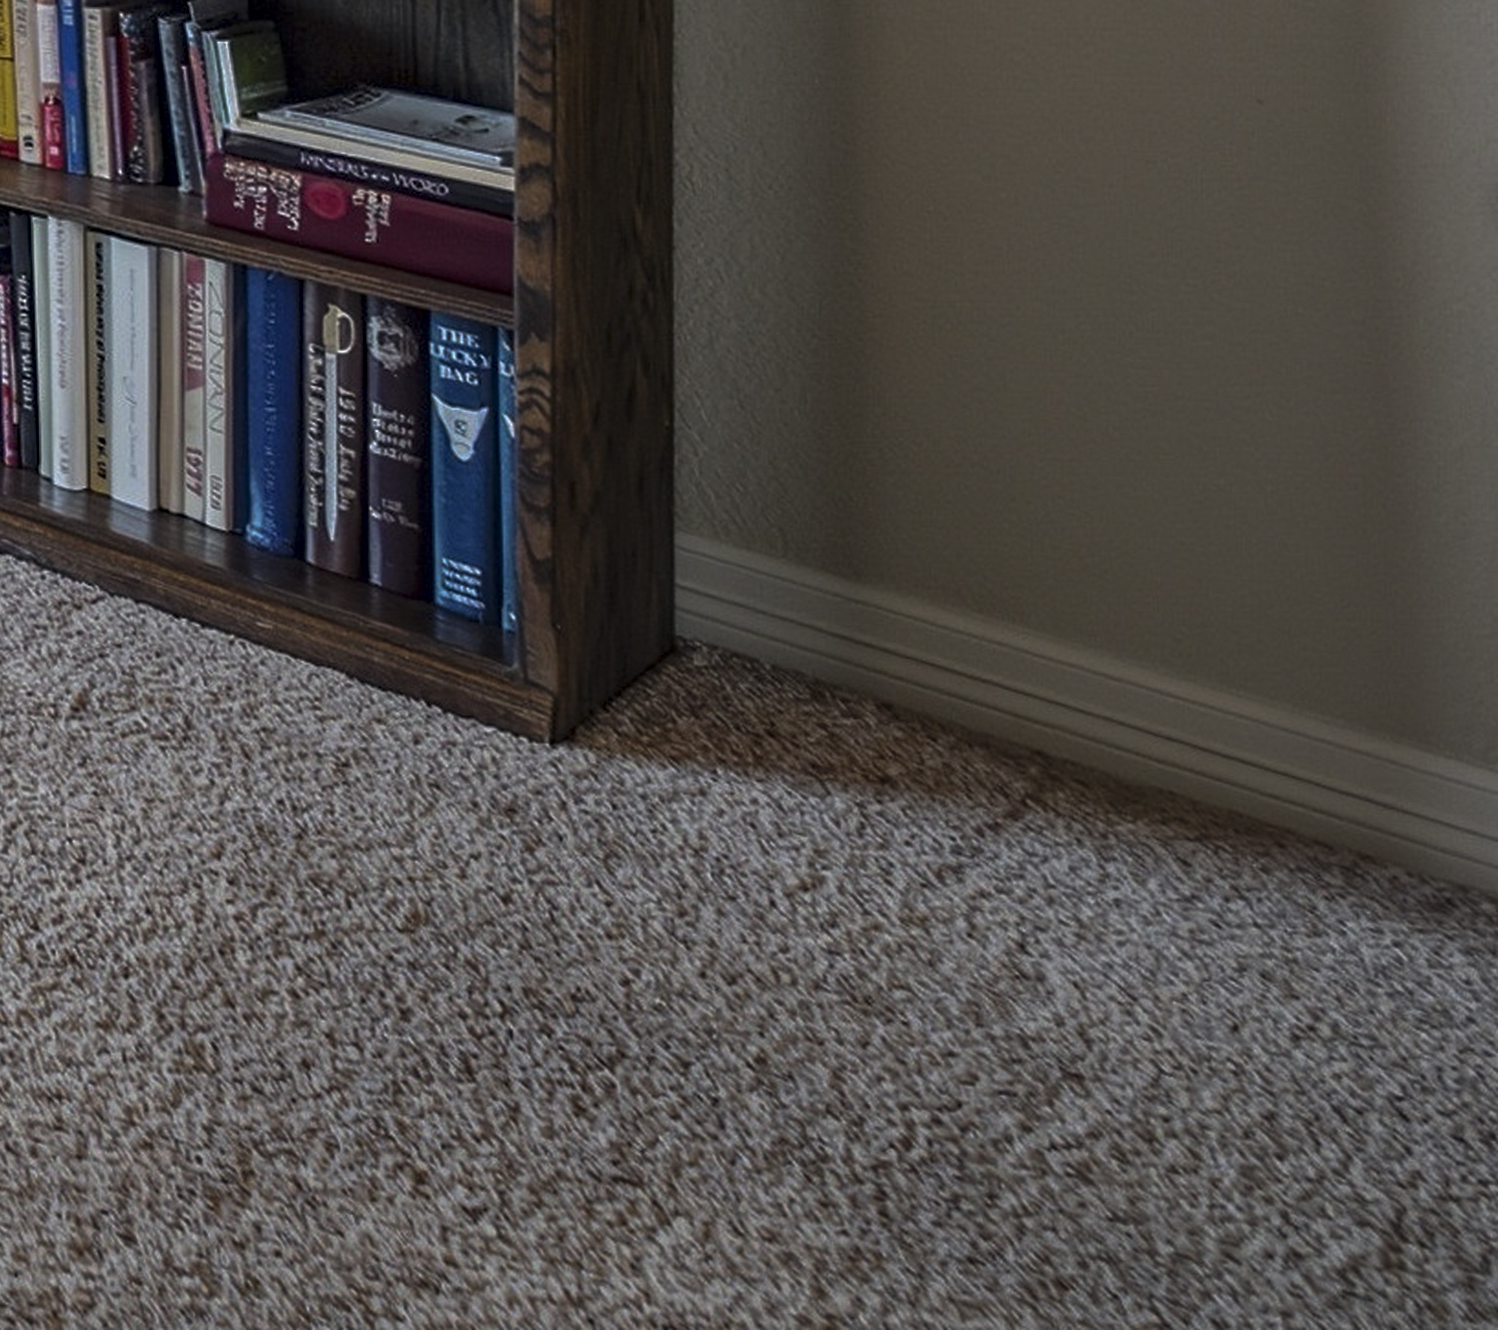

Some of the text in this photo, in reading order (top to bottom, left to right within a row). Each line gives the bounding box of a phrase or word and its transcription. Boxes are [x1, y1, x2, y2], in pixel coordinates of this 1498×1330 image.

[187, 283, 205, 371] ZONIAN
[437, 325, 481, 349] THE
[207, 282, 226, 435] ZONIAN
[429, 339, 492, 372] LUCKY
[439, 361, 479, 386] BAG
